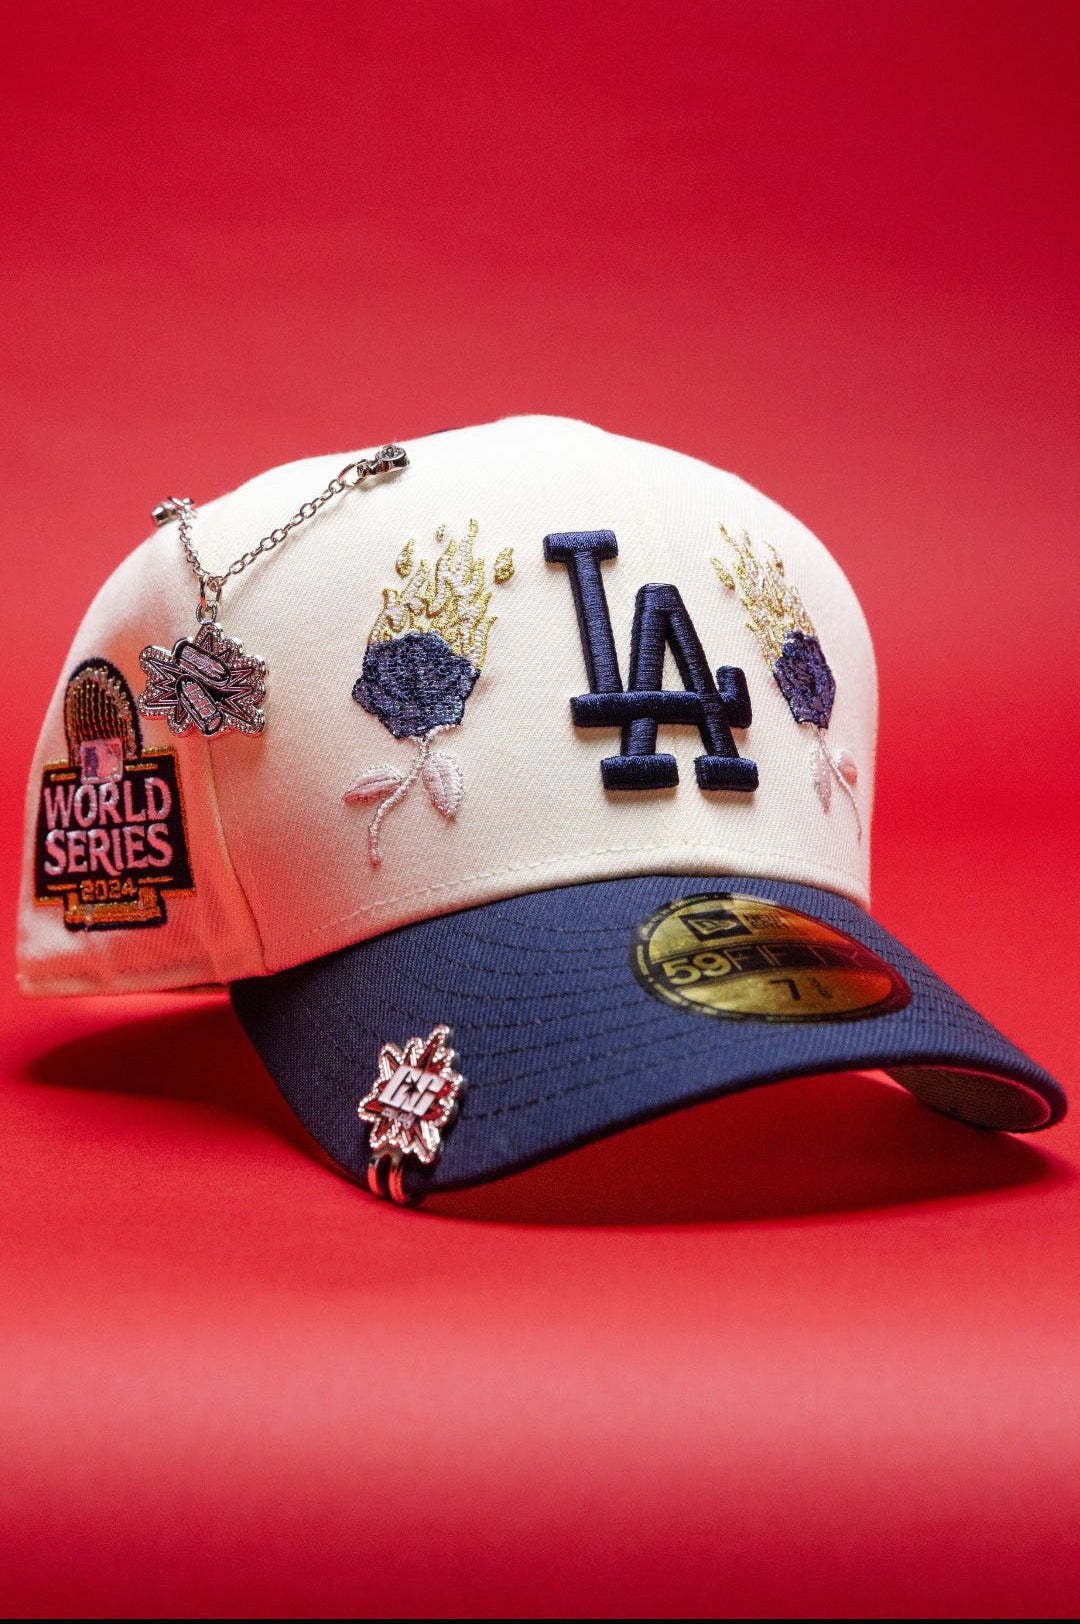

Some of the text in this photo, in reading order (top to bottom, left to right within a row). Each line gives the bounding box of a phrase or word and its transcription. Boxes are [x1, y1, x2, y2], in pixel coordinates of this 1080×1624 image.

[543, 529, 759, 792] LA
[43, 777, 173, 829] WORLD
[43, 822, 174, 876] SERIES
[79, 878, 138, 900] 2024
